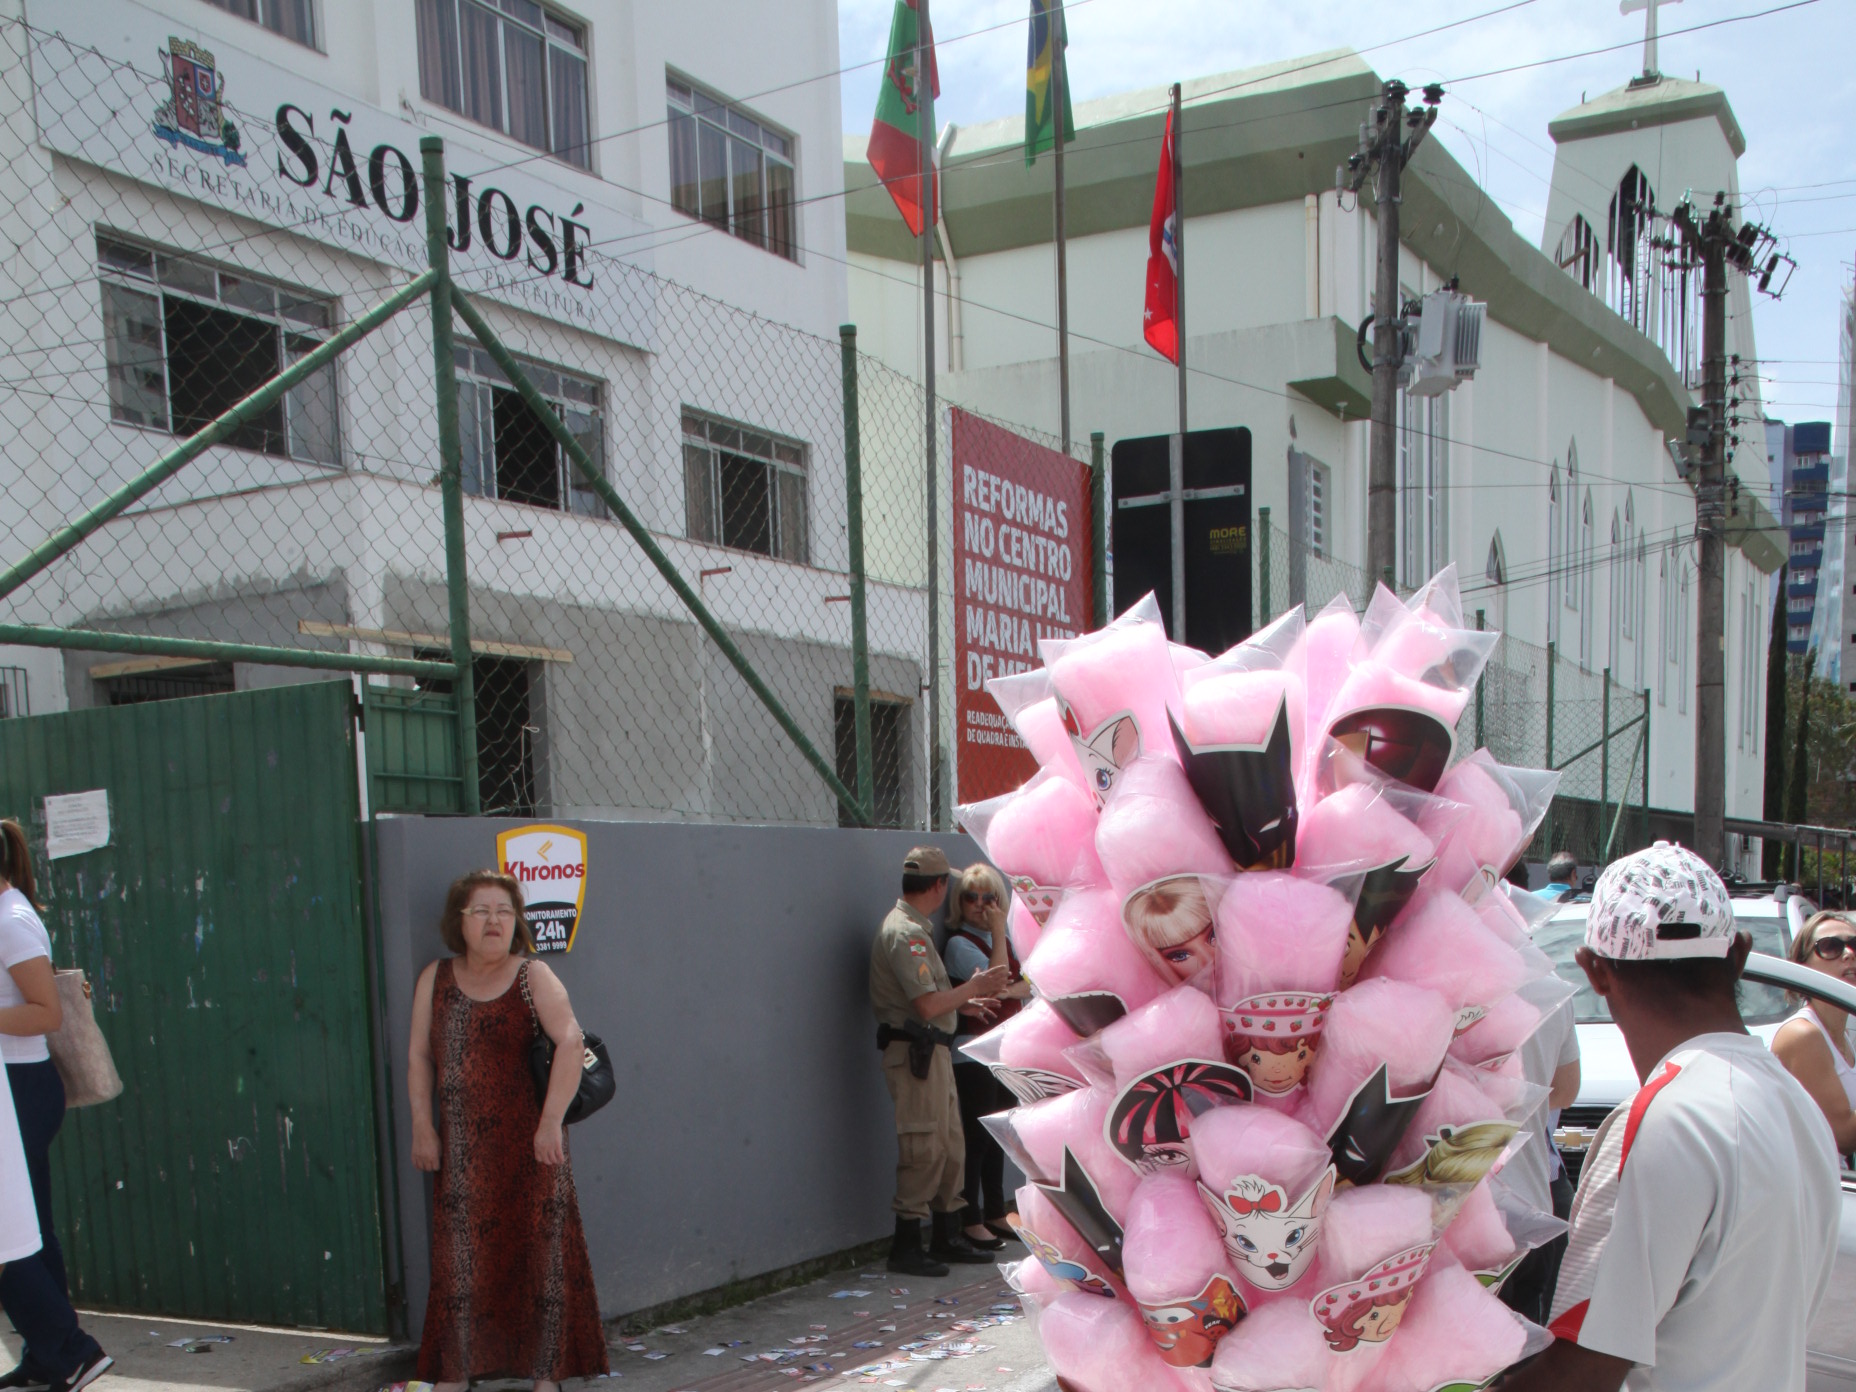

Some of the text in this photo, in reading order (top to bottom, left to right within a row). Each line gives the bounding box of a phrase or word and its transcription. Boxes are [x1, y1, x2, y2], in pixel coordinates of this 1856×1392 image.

[153, 152, 297, 218] SECRETARIA
[303, 205, 329, 230] DE
[275, 103, 595, 291] SÃO JOSÉ
[486, 268, 596, 322] PREFEITURA
[963, 463, 1069, 539] REFORMAS
[964, 511, 1072, 582] NO CENTRO
[1209, 525, 1247, 540] MORE
[965, 557, 1071, 624] MUNICIPAL
[966, 604, 1033, 657] MARIA
[967, 651, 993, 693] DE
[966, 728, 976, 742] DE
[976, 730, 1004, 746] QUADRA
[503, 860, 586, 882] Khronos
[535, 921, 567, 941] 24h
